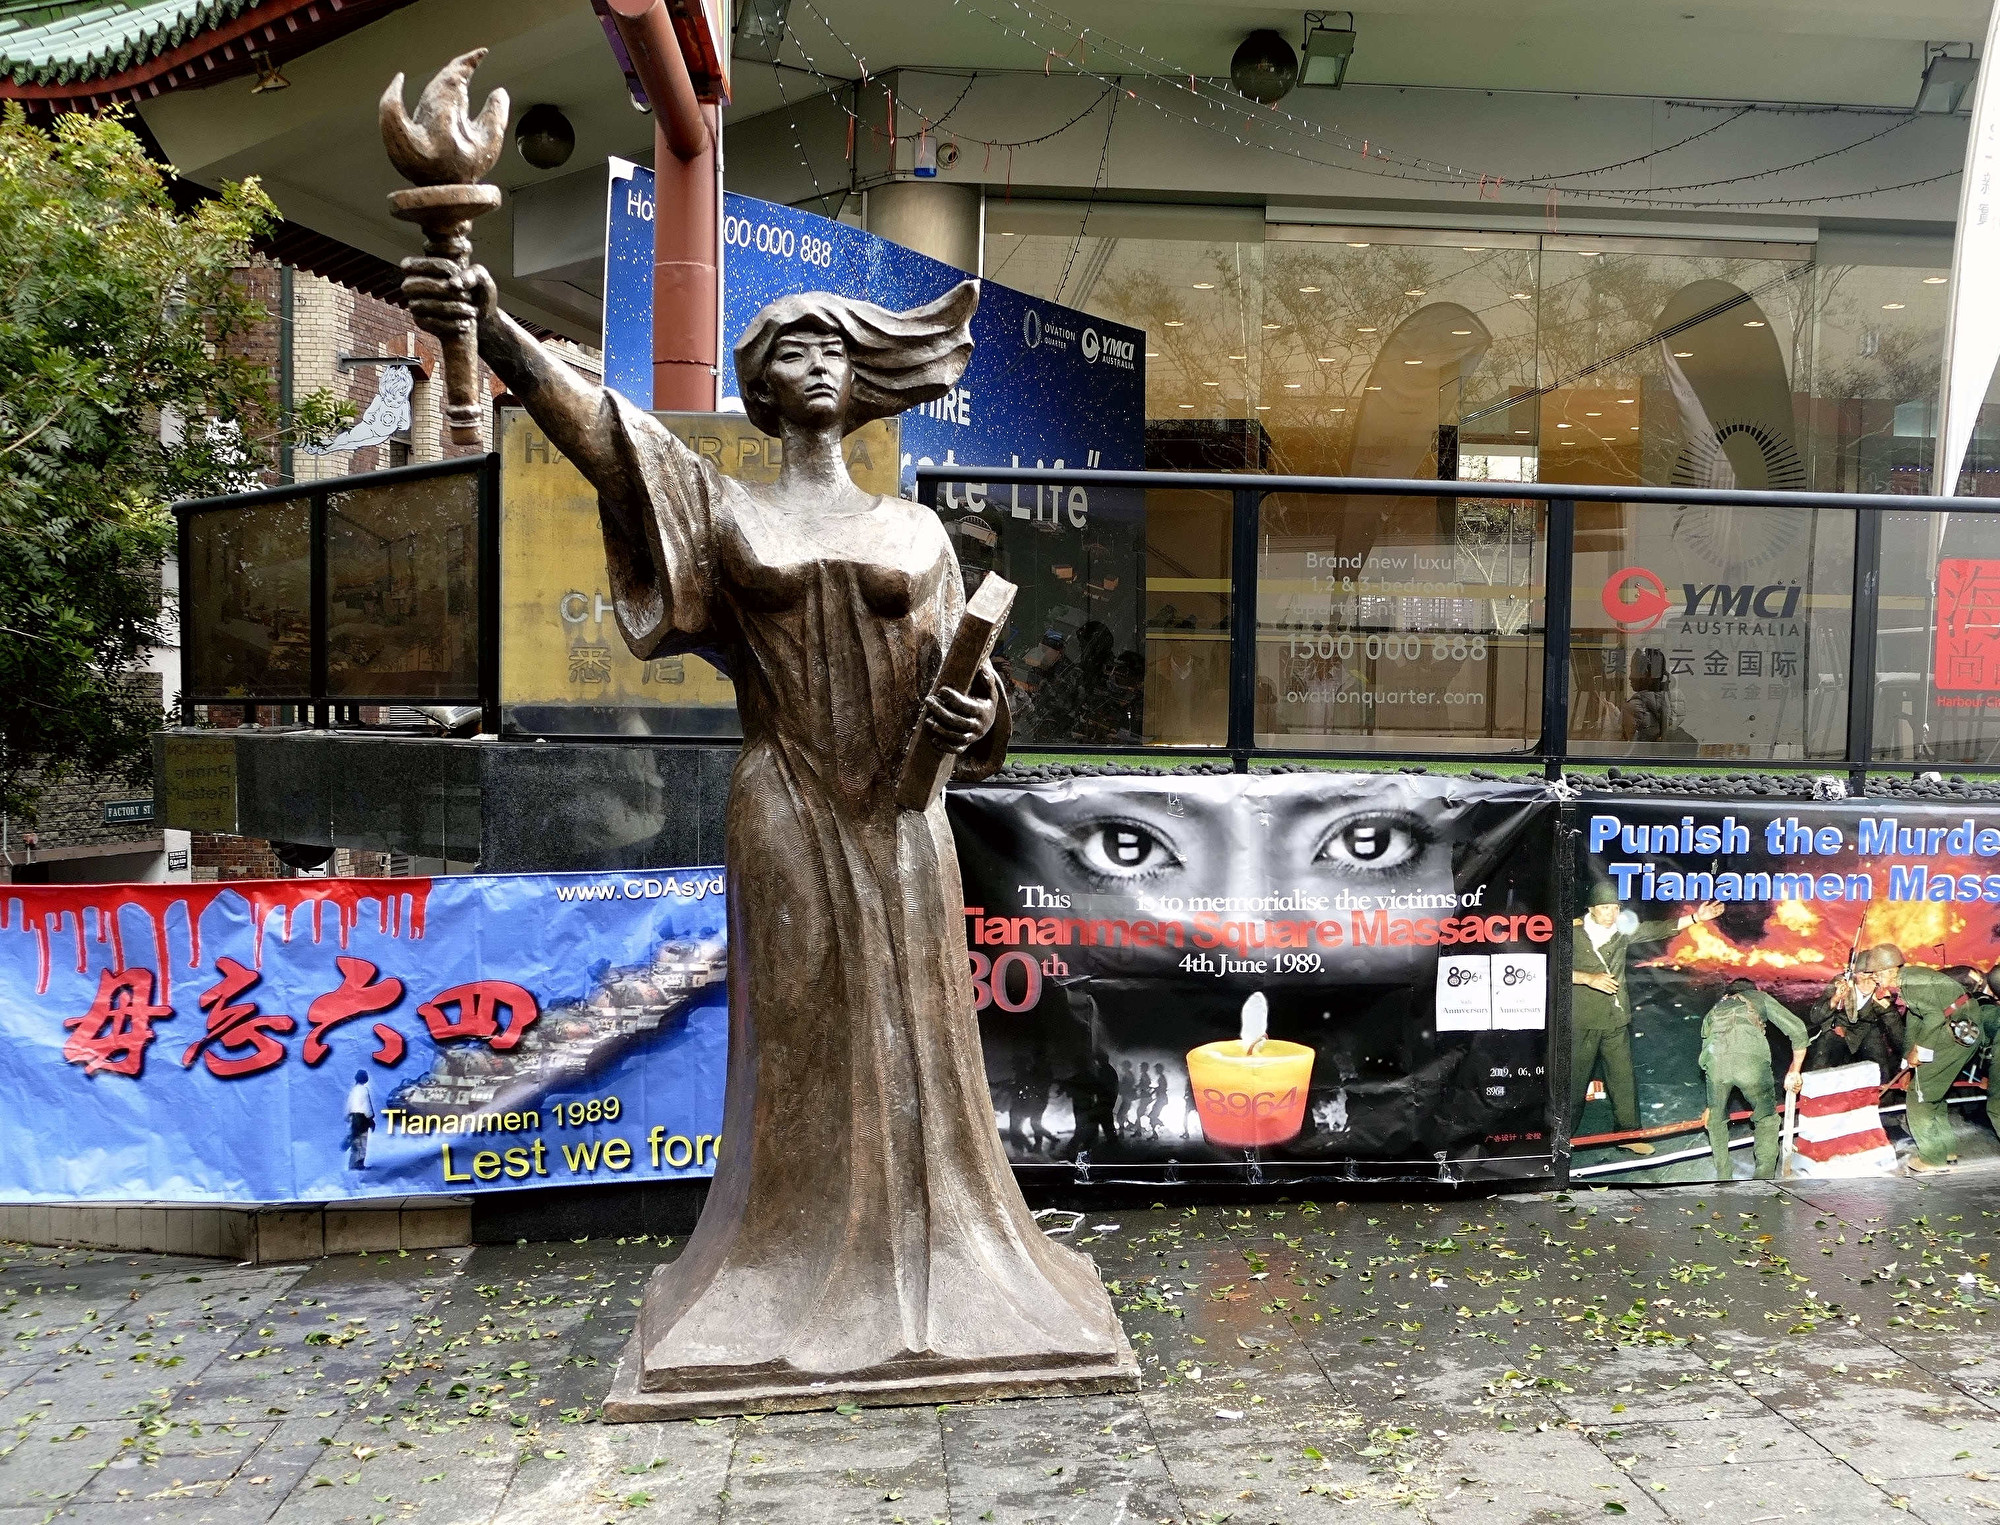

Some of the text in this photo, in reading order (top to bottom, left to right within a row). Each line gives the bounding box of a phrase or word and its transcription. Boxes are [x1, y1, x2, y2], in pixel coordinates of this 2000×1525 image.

[756, 224, 795, 257] 000
[800, 235, 831, 268] 888
[1044, 323, 1076, 341] OVATION
[1044, 337, 1067, 350] QUARTER
[1102, 335, 1135, 361] YMCI
[1102, 356, 1135, 371] AUSTRALIA
[907, 388, 971, 426] HIRE
[1306, 552, 1362, 569] Brand
[1368, 558, 1407, 569] new
[1342, 576, 1357, 593] &
[1682, 583, 1802, 618] YMCI
[1681, 622, 1800, 637] AUSTRALIA
[1365, 635, 1421, 660] 000
[1432, 635, 1488, 660] 888
[1287, 689, 1484, 708] ovationquarter.com
[1937, 696, 1983, 708] Harbour
[108, 806, 140, 817] FACTORY
[1589, 815, 2000, 858] Punish the Murde
[1608, 862, 2000, 902] Tiananmen Mass
[1017, 884, 1487, 913] This is to memorialise the victims of
[1192, 911, 1344, 958] Square
[1351, 909, 1554, 947] Massacre
[1178, 952, 1326, 978] 4th June 1989.
[1443, 1006, 1489, 1015] Anniversary
[1517, 1066, 1531, 1077] 06,
[1535, 1065, 1545, 1075] 04
[1203, 1086, 1297, 1118] 8964
[1486, 1086, 1505, 1096] 8964
[381, 1095, 620, 1135] Tiananmen 1989
[441, 1137, 548, 1182] Lest
[562, 1136, 632, 1172] we
